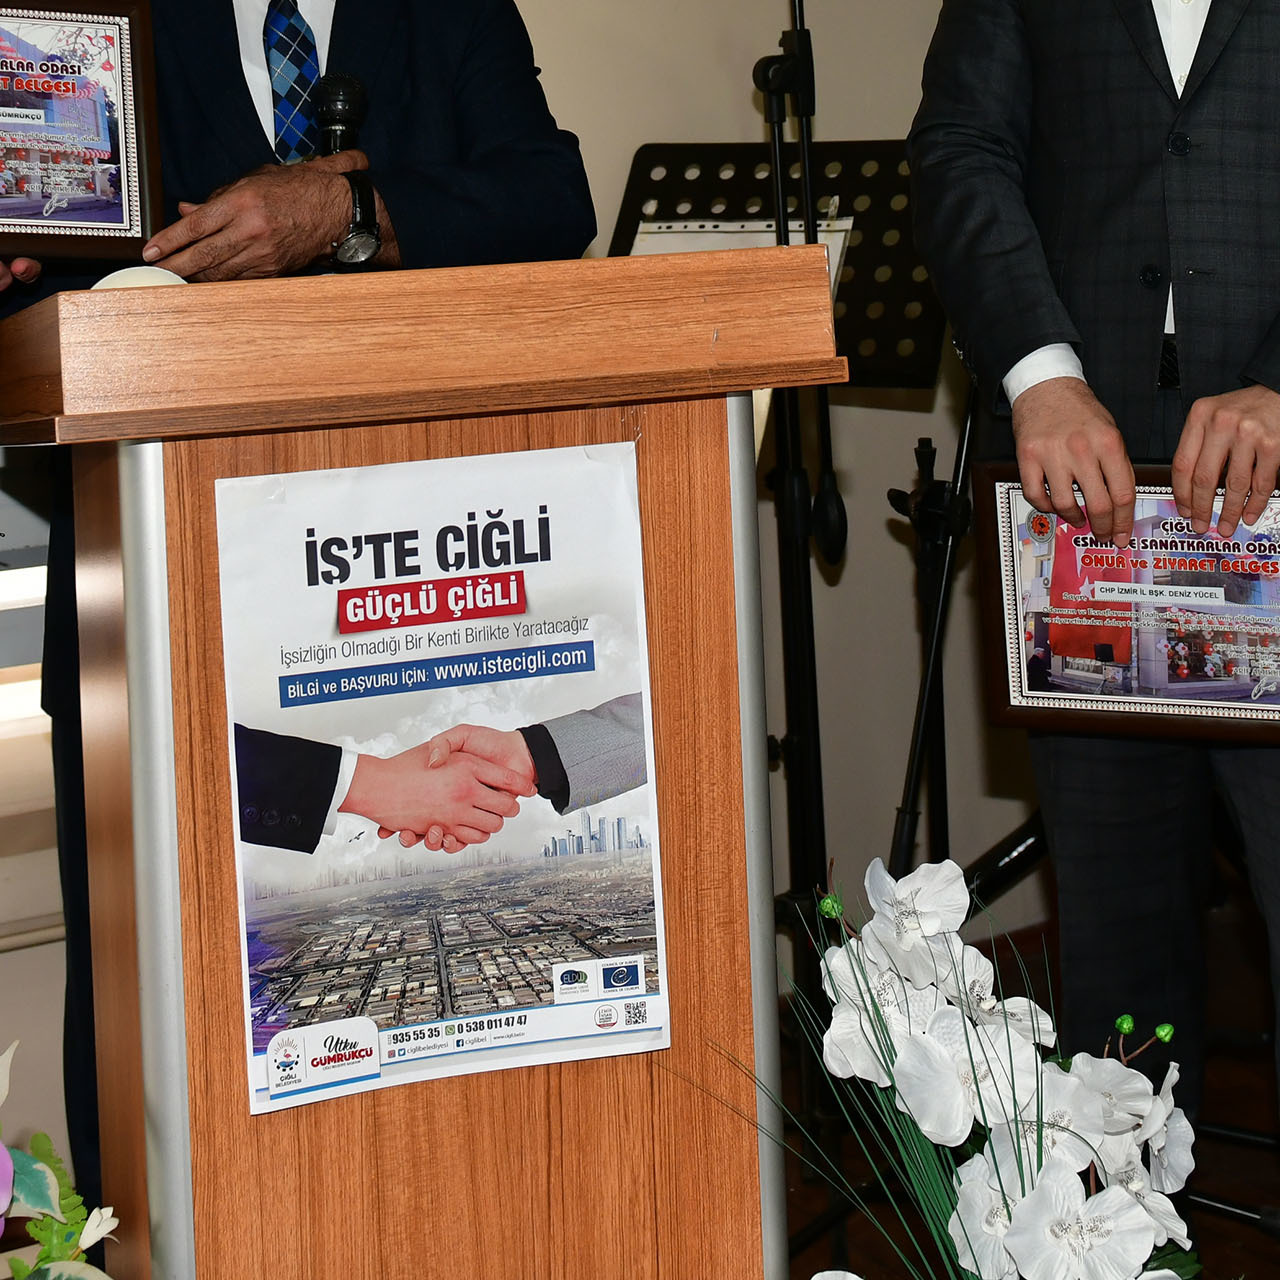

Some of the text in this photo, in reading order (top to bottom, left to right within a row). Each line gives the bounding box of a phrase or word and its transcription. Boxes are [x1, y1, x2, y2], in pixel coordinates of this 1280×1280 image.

[39, 62, 82, 75] ODASI
[14, 78, 76, 94] BELGESİ
[1161, 517, 1196, 535] ÇİĞL
[436, 505, 551, 572] ÇİĞLİ
[1141, 536, 1241, 553] SANÂTKARLAR
[1081, 554, 1126, 568] ONUR
[1130, 559, 1148, 569] ve
[1153, 554, 1216, 571] ZİYARET
[346, 575, 518, 625] GÜÇLÜ ÇİĞLİ
[1099, 585, 1219, 599] CHP İZMİR İL BŞK. DENİZ YÜCEL
[280, 615, 589, 669] İşsizliğin Olmadığı Bir Kenti Birlikte Yaratacağız
[287, 649, 587, 699] BİLGİ ve BAŞVURU İÇİN: www.istecigli.com
[457, 1014, 527, 1034] 0 538 011 47 47
[323, 1035, 360, 1053] Utku
[392, 1031, 411, 1045] 935
[413, 1029, 426, 1041] 55
[427, 1026, 440, 1039] 35
